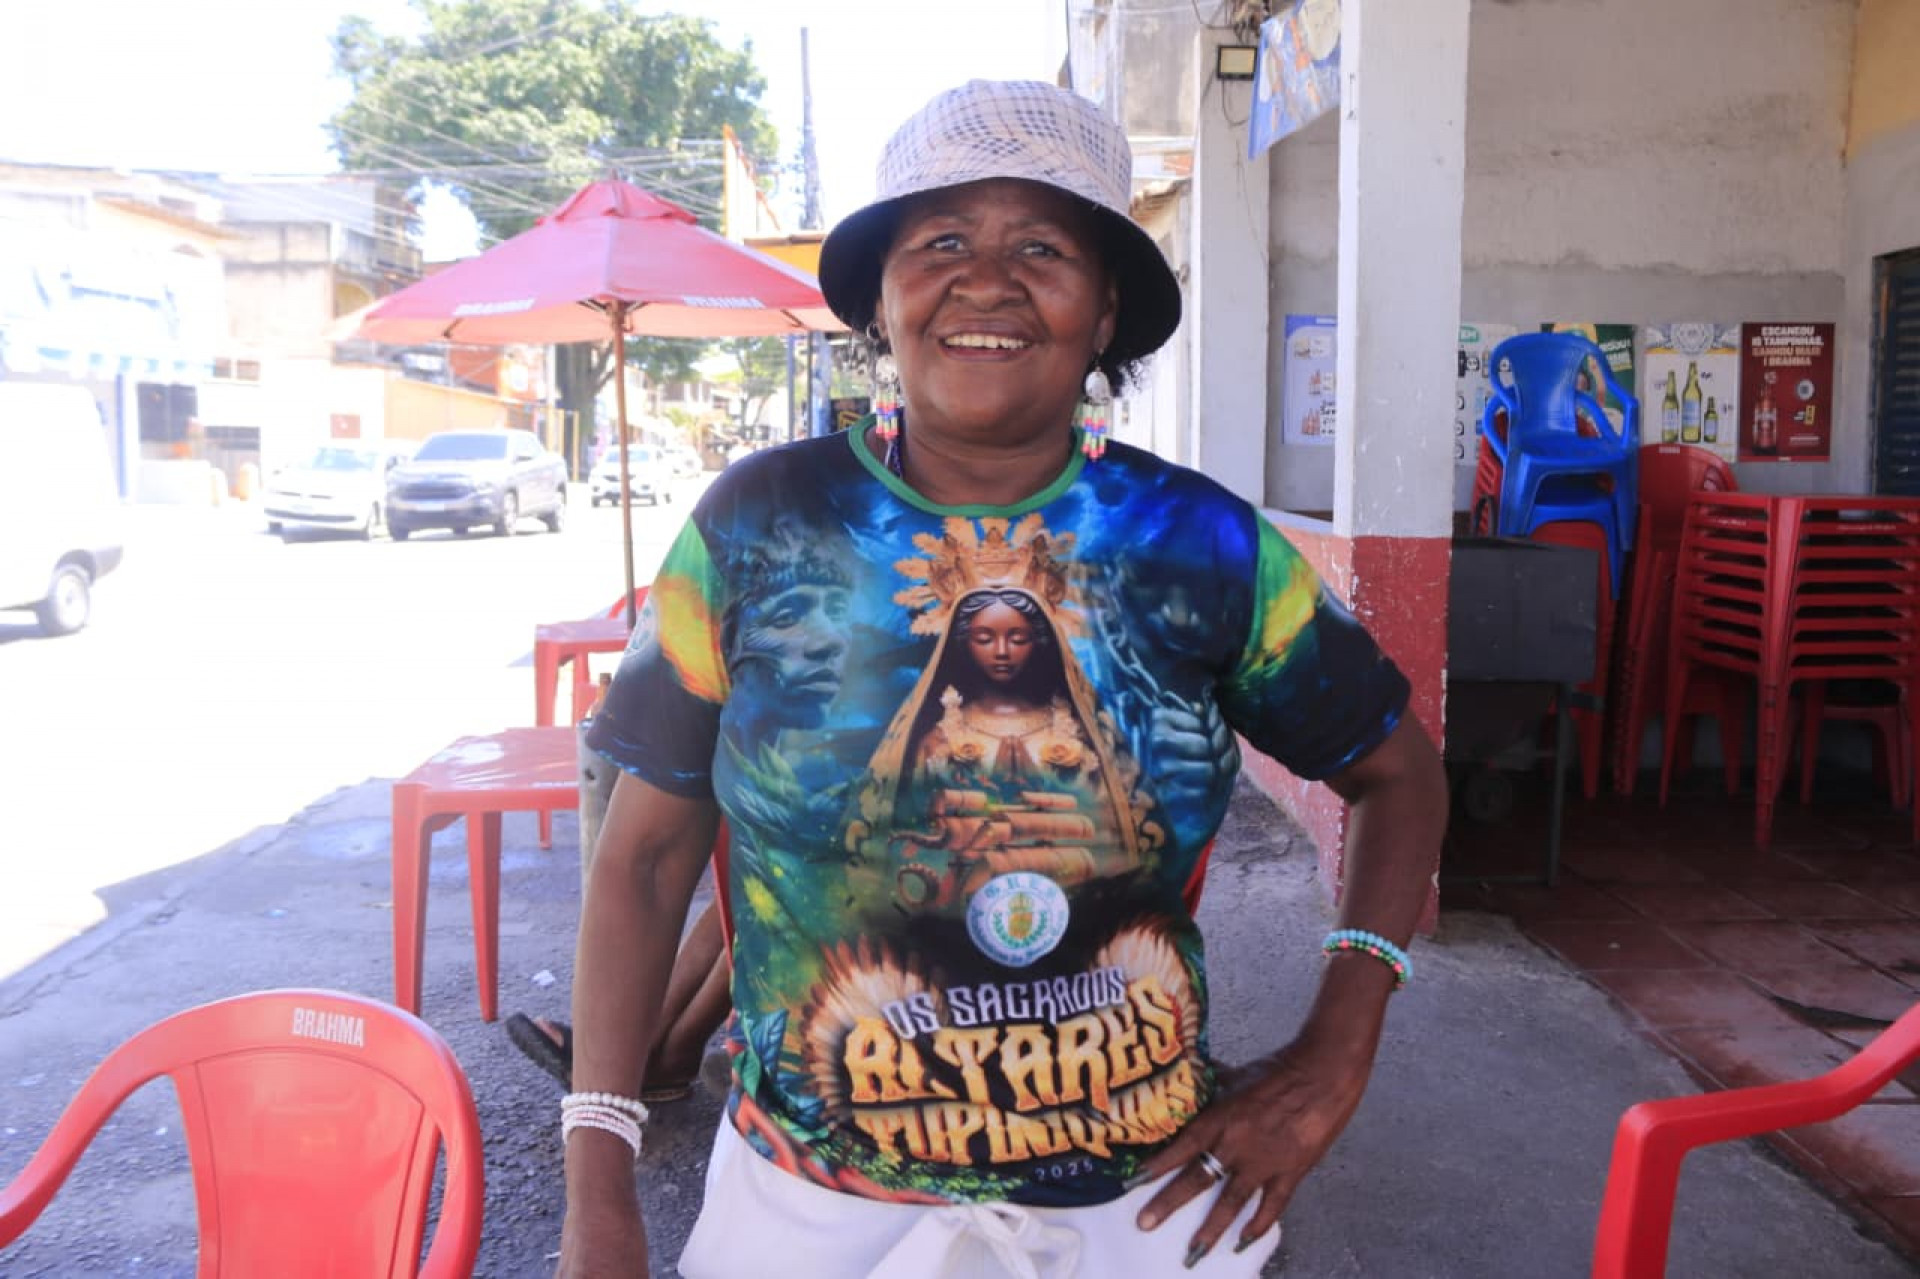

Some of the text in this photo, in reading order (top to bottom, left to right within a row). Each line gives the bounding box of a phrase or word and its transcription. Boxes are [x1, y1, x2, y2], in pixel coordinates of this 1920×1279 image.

[292, 1007, 364, 1048] BRAHMA
[882, 966, 1127, 1040] OS SAGRADOS
[843, 975, 1182, 1112] ALTARES
